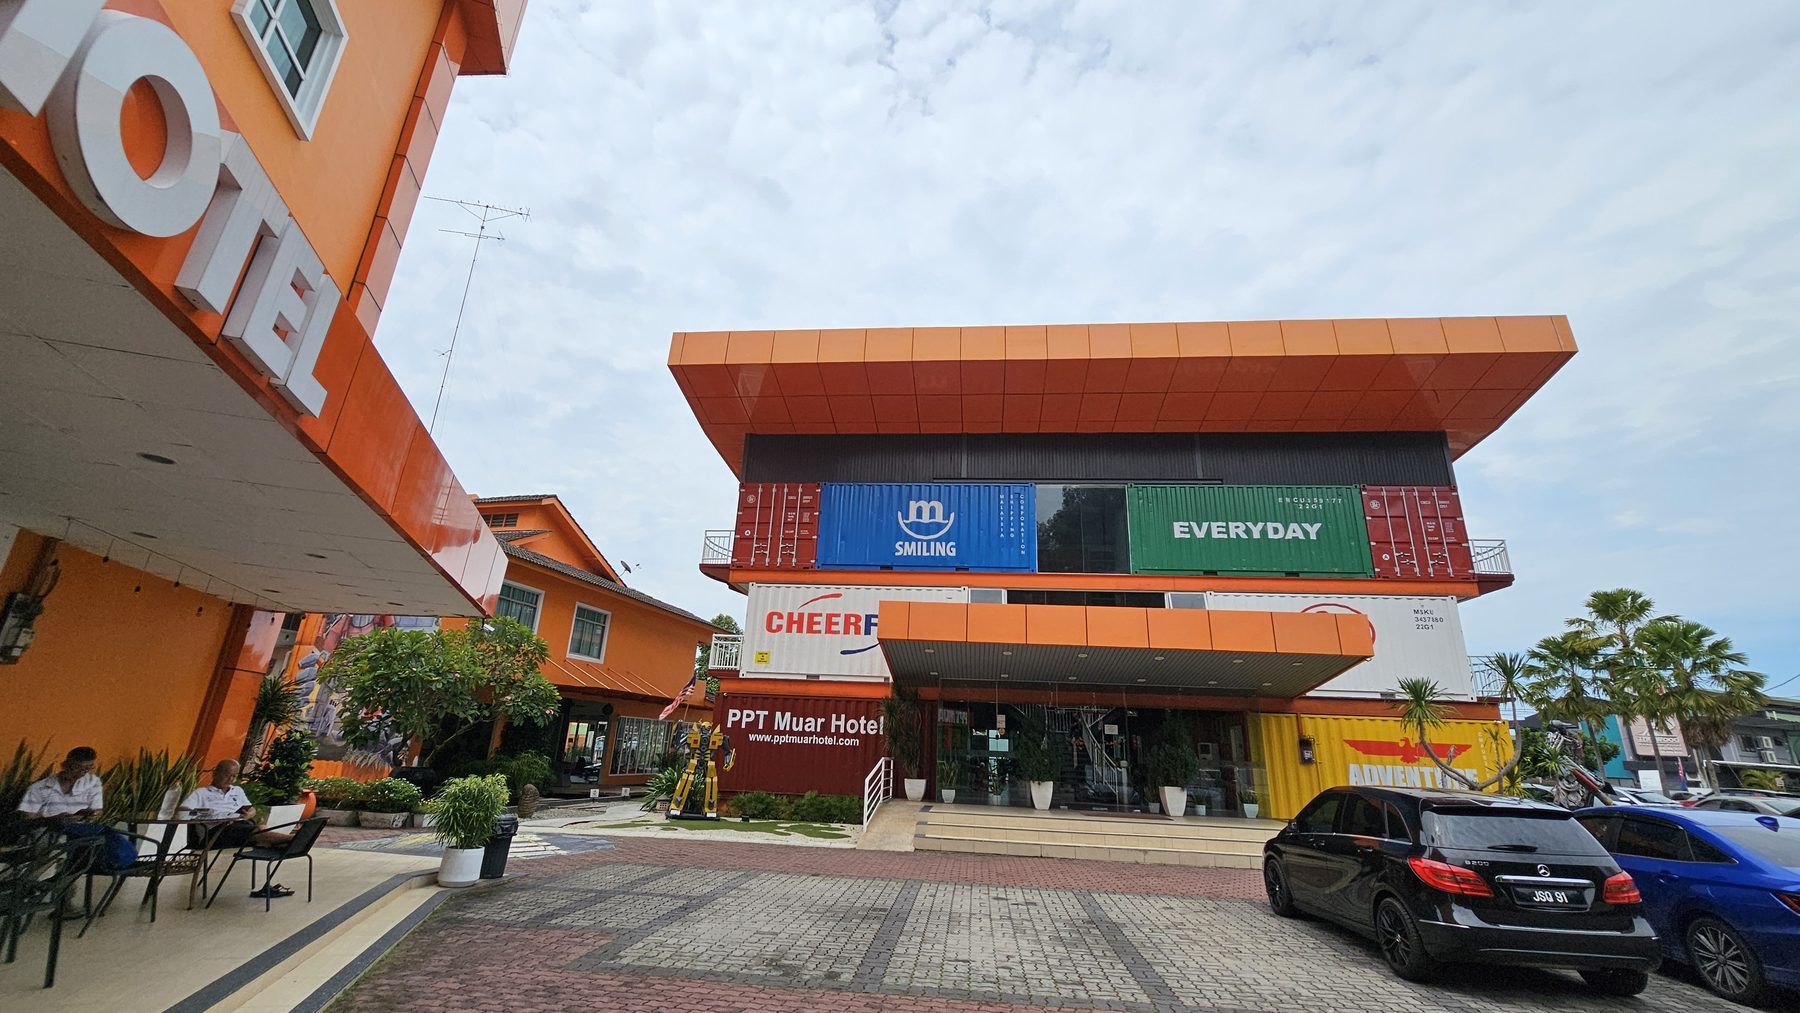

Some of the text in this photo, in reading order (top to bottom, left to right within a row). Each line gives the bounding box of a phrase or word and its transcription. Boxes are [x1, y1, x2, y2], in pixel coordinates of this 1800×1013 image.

[1173, 521, 1322, 540] EVERYDAY
[895, 541, 957, 557] SMILING
[765, 611, 879, 636] CHEERF
[727, 709, 884, 735] PPT Muar Hotel
[749, 733, 860, 747] www.pptmuarhotel.com
[1533, 890, 1569, 904] JSQ 91
